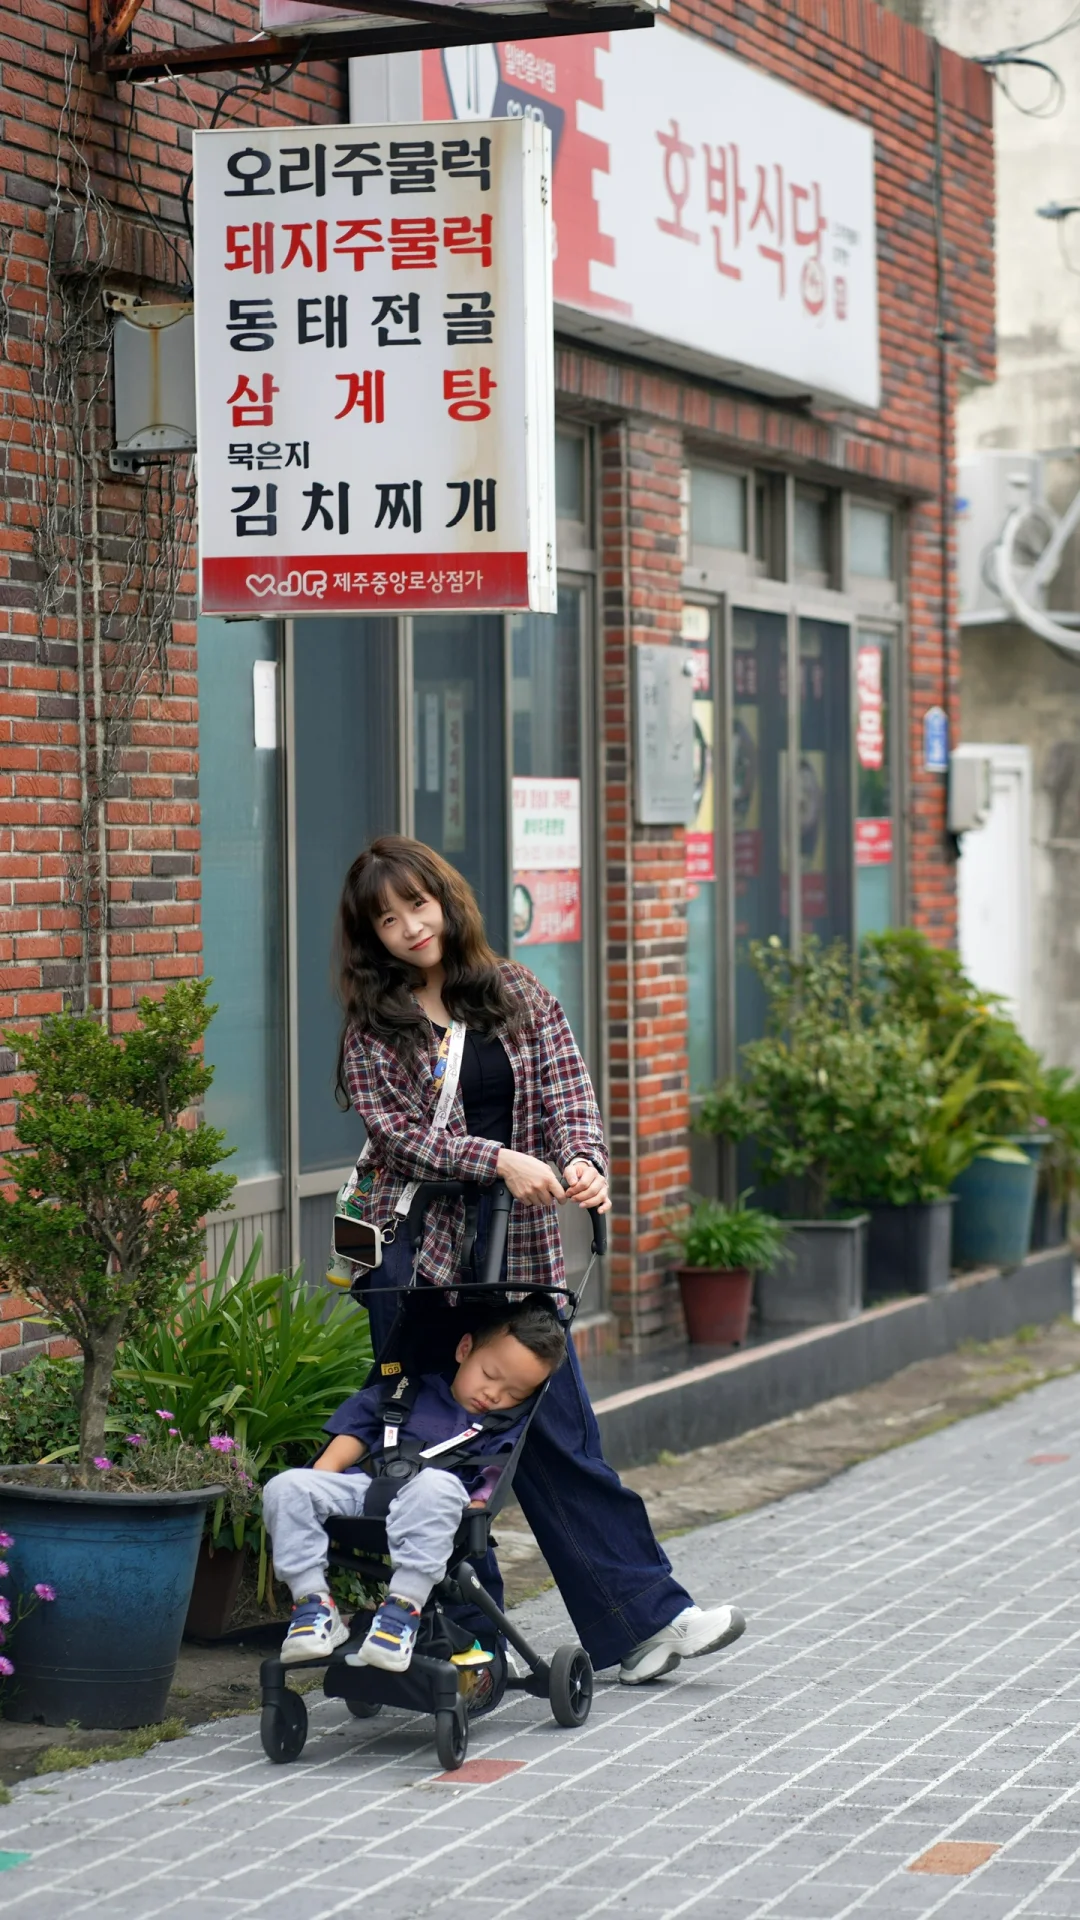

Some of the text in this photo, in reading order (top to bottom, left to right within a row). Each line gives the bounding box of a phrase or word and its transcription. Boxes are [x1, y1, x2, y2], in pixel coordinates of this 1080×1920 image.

[223, 136, 492, 198] 오리주물럭
[656, 118, 828, 315] 호반식당
[224, 213, 493, 275] 돼지주물럭
[227, 440, 310, 471] 묵은지
[333, 570, 484, 596] 제주중앙로상점가
[447, 1052, 461, 1078] Disney
[435, 1092, 454, 1121] Disney
